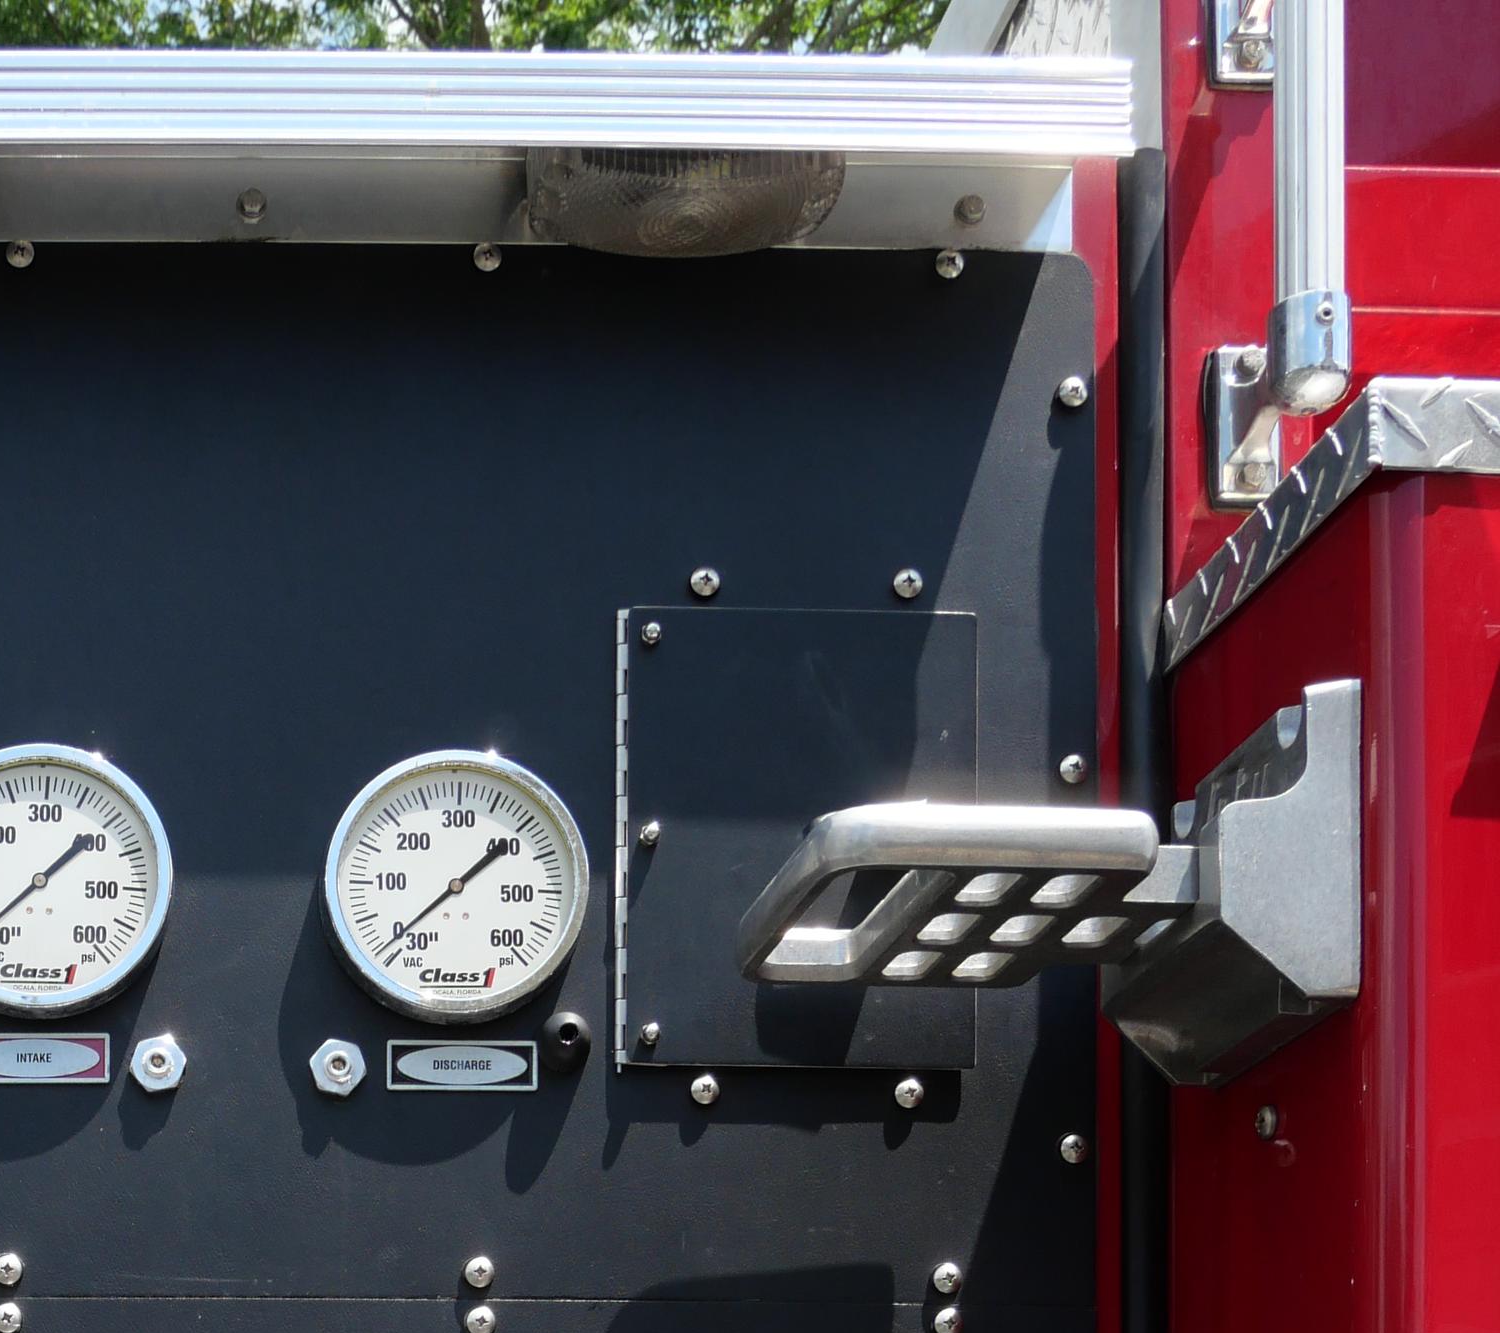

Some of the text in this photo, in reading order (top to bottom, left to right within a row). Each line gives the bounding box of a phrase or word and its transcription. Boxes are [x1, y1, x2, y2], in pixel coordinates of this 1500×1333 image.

[28, 804, 62, 823] 300
[441, 810, 475, 828] 300
[396, 832, 431, 851] 200
[85, 881, 118, 900] 500
[375, 872, 407, 891] 100
[500, 884, 534, 903] 500
[73, 926, 107, 944] 600
[490, 929, 524, 947] 600
[16, 1052, 53, 1064] INTAKE
[432, 1059, 492, 1071] DISCHARGE
